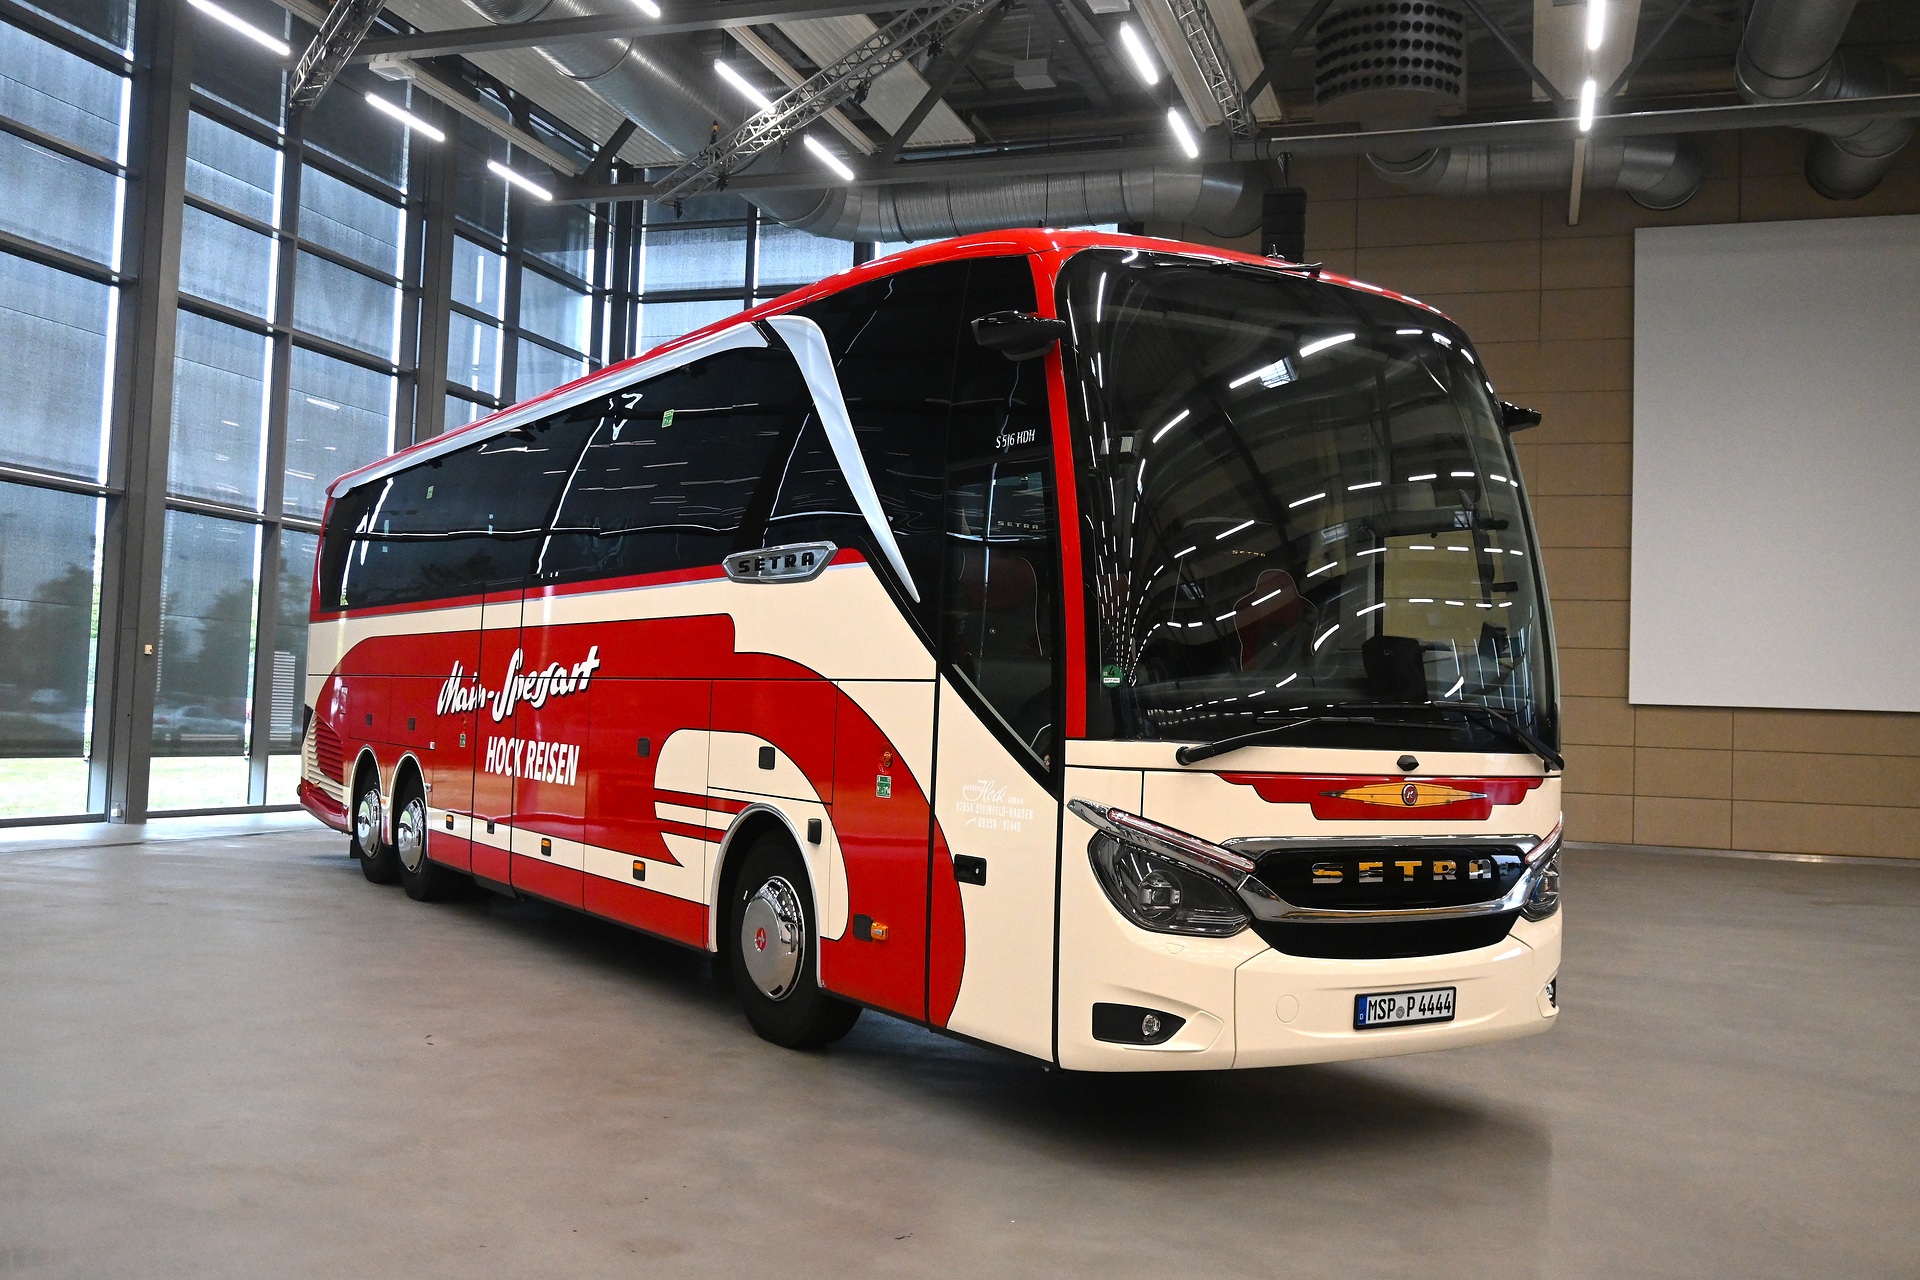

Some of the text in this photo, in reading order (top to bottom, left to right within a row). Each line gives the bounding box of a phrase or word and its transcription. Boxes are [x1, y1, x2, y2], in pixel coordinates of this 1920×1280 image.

[995, 428, 1036, 449] S 516 HDH
[997, 520, 1039, 530] SETRA
[737, 551, 816, 574] SETRA
[1108, 666, 1116, 677] 4
[484, 736, 581, 787] HOCK REISEN
[1311, 859, 1492, 884] SETRA
[1359, 1013, 1364, 1021] D
[1367, 993, 1452, 1021] MSP P 4444
